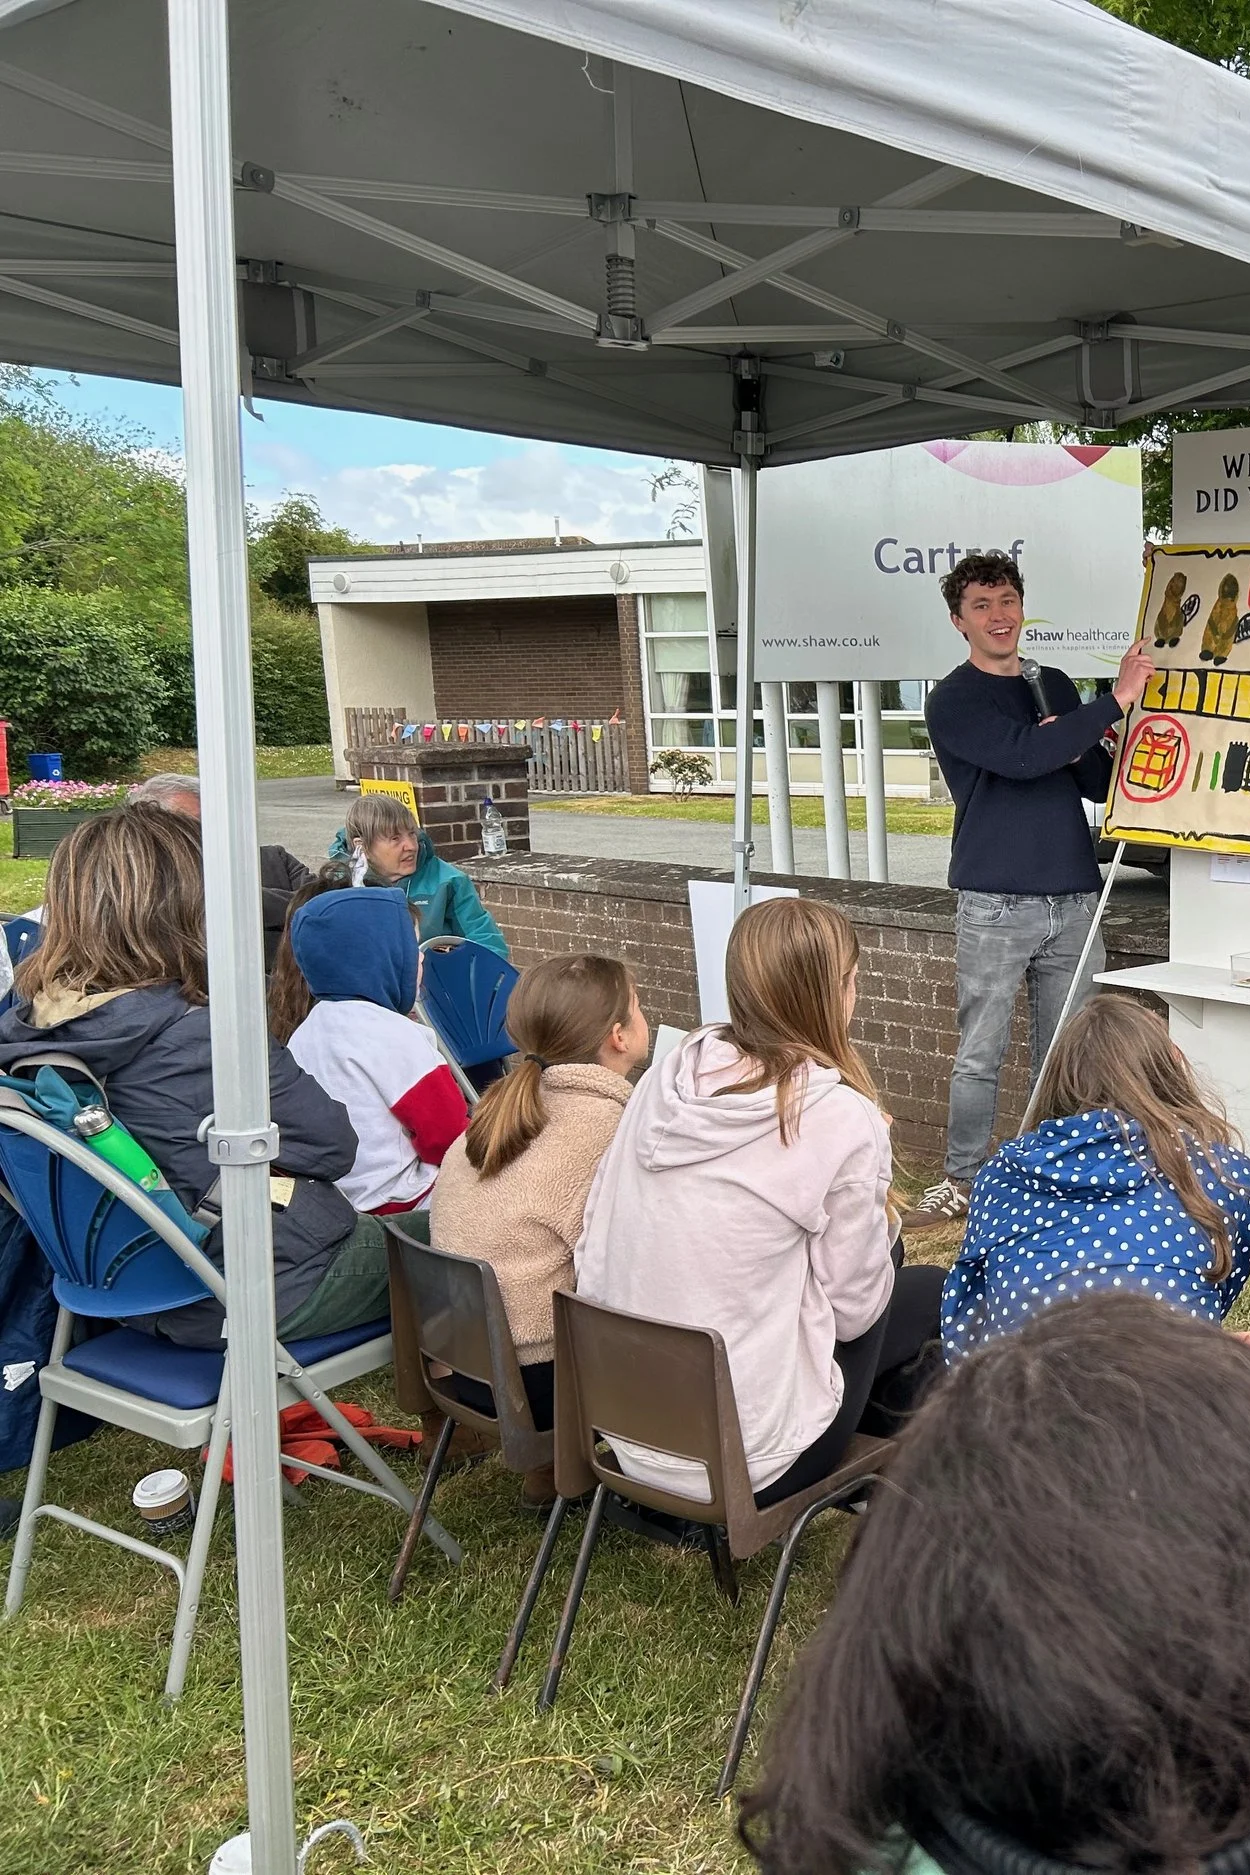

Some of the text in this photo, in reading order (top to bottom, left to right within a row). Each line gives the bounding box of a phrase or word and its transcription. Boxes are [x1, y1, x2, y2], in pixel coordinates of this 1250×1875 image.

[1195, 486, 1239, 514] DID
[874, 537, 1025, 574] Cartf
[761, 635, 880, 647] www.shaw.co.uk
[1025, 628, 1130, 641] Shaw healthcare
